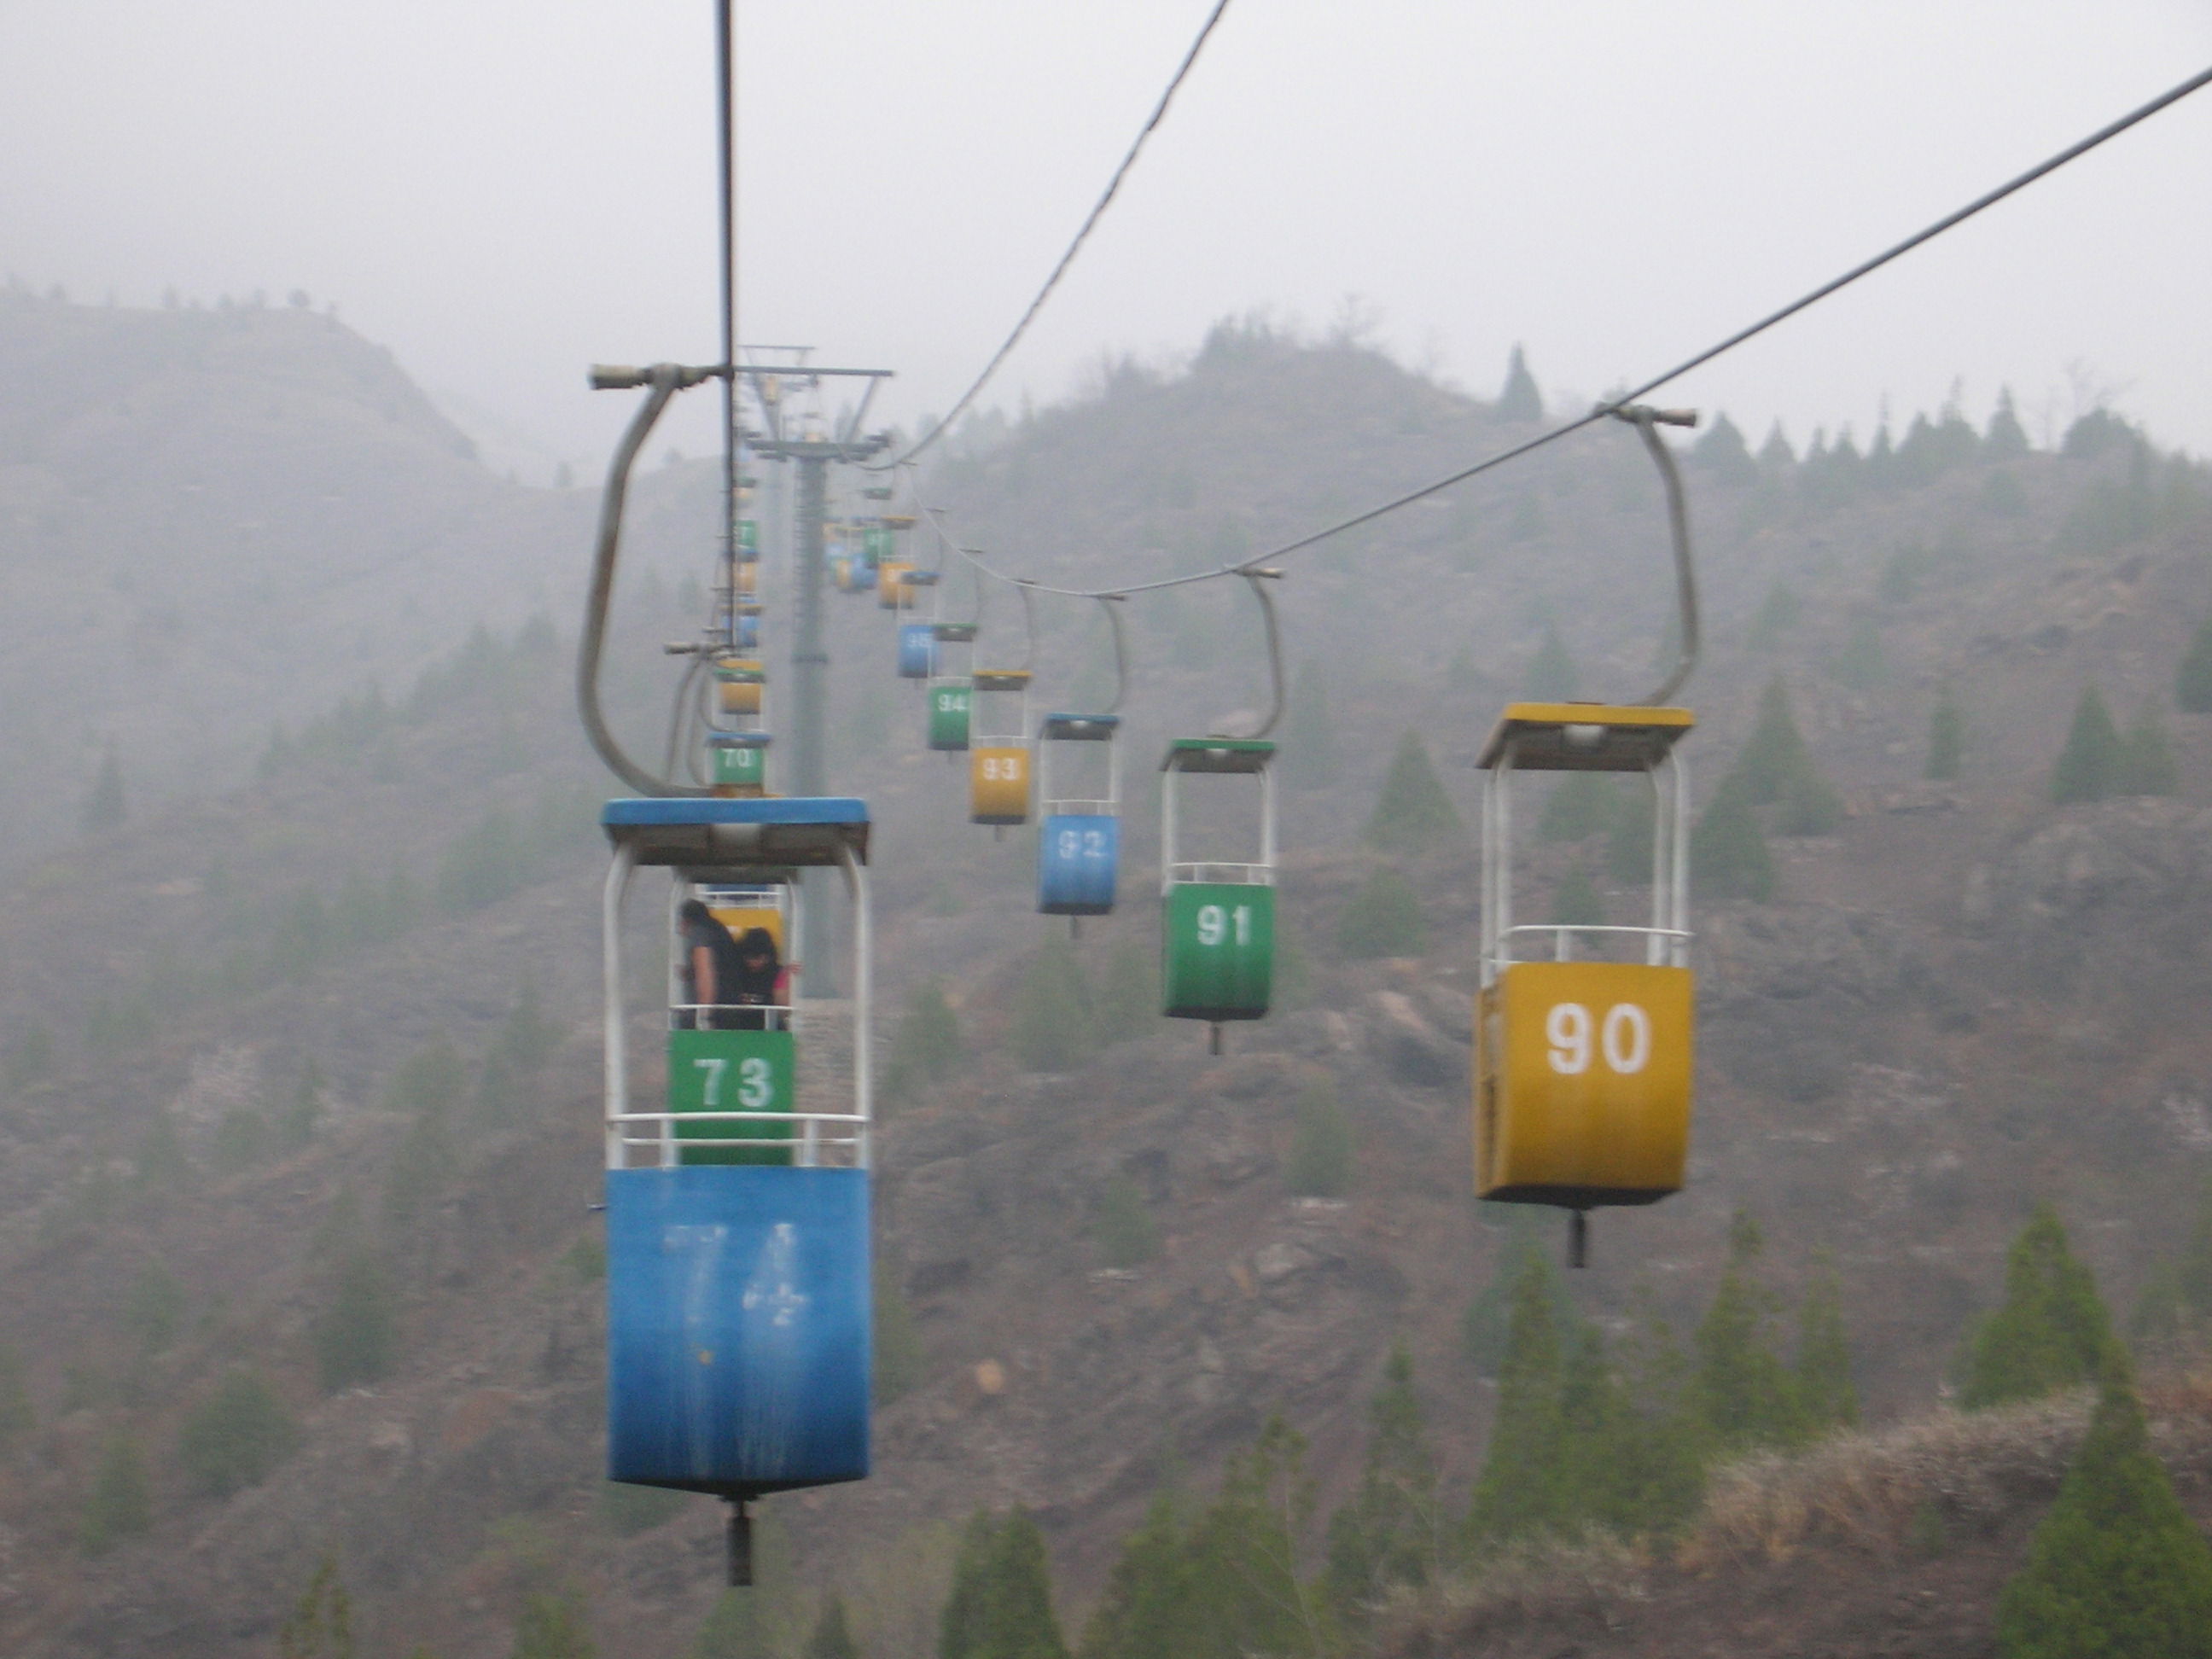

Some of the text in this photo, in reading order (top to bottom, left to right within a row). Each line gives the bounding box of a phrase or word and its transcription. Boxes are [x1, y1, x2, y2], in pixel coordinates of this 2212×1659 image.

[939, 694, 967, 712] 94
[983, 757, 1021, 780] 93
[1196, 905, 1251, 946] 91
[1545, 1002, 1651, 1074] 90
[694, 1057, 772, 1107] 73
[663, 1223, 808, 1324] 74
